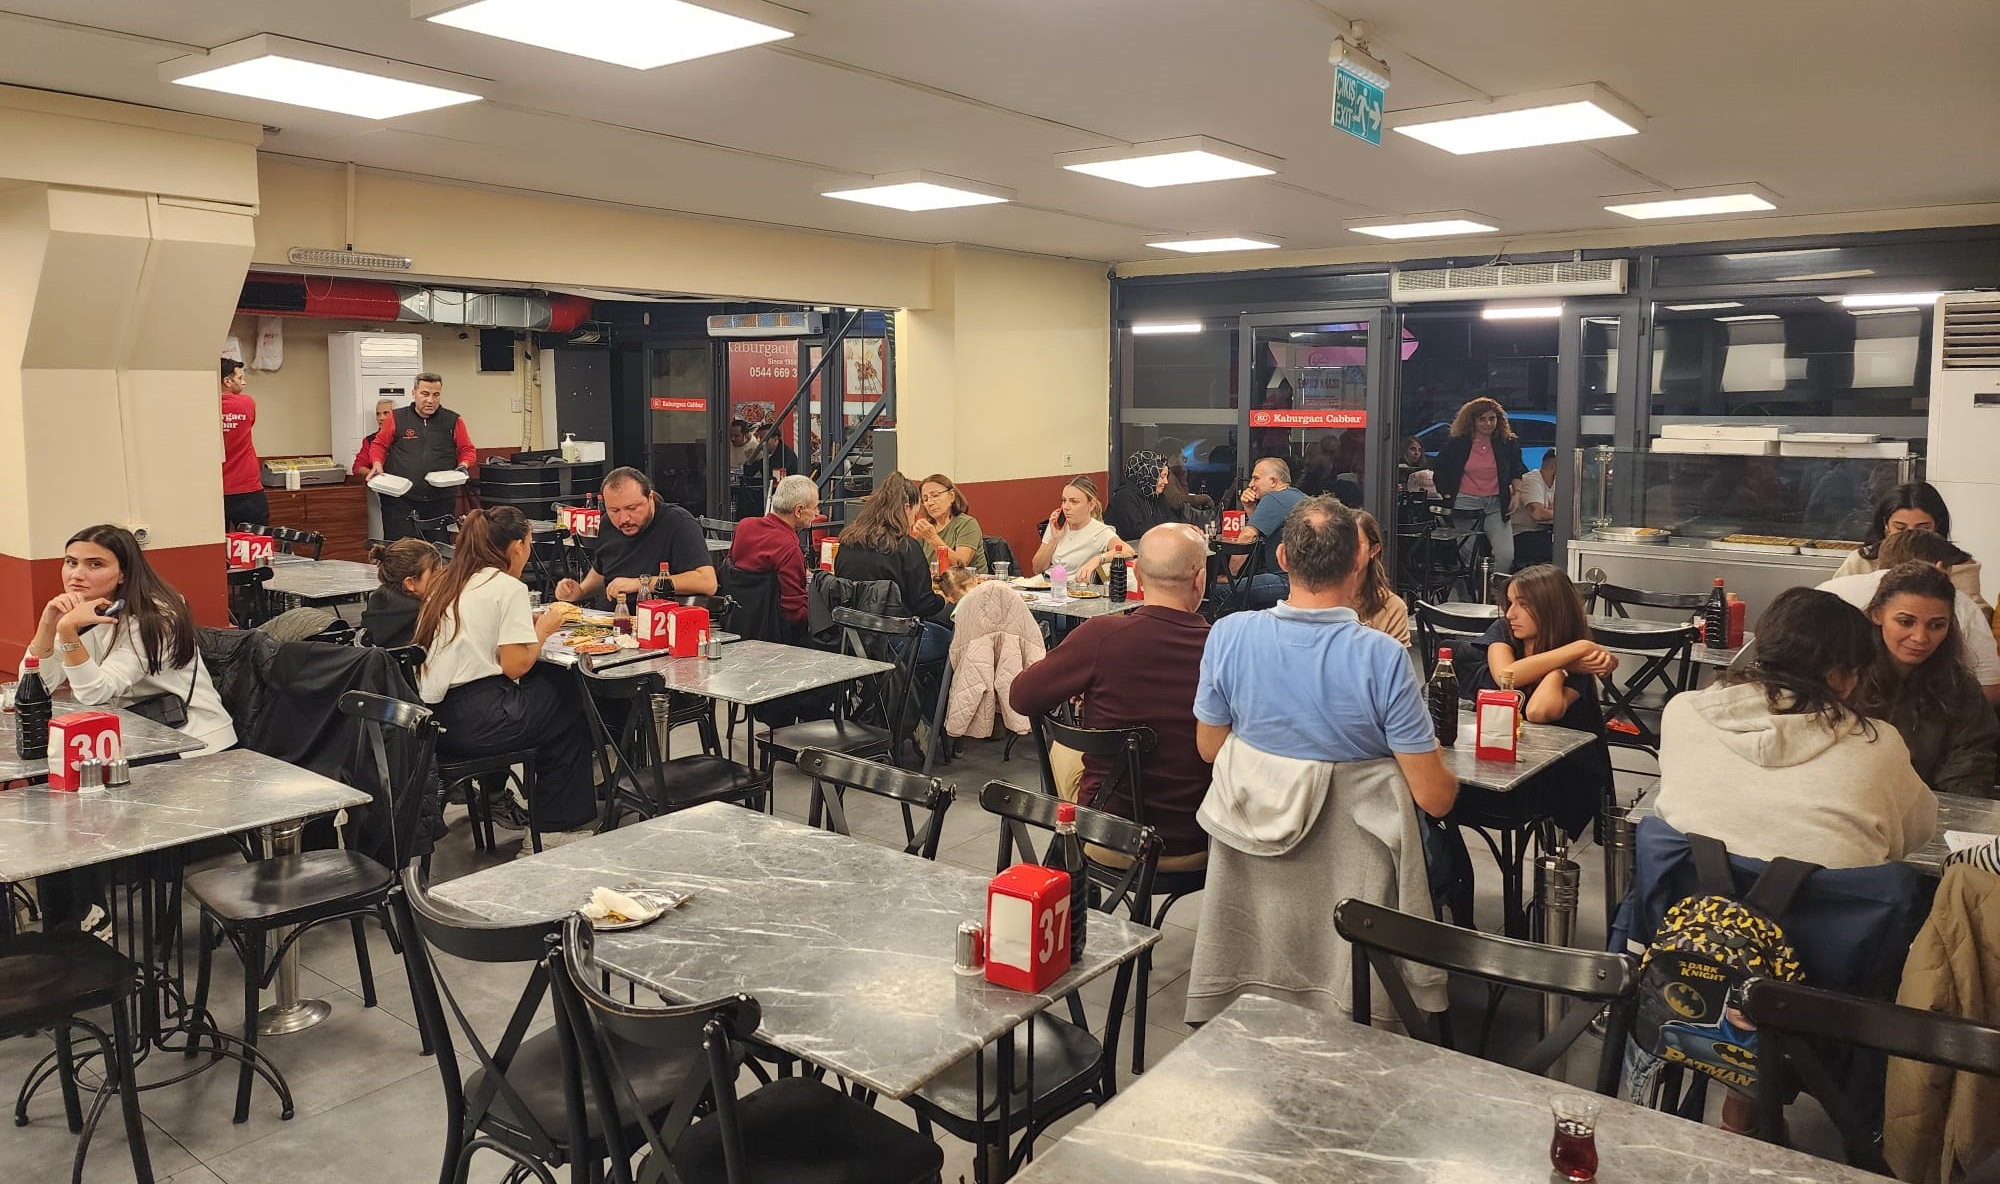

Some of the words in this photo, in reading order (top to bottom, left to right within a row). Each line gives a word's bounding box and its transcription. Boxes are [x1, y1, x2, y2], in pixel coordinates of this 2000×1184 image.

[1336, 73, 1356, 106] ÇIKIŞ
[1335, 104, 1354, 129] EXIT
[749, 367, 771, 378] 0544
[774, 367, 790, 378] 669
[1273, 414, 1323, 424] Kaburgacı
[1326, 414, 1361, 423] Cabbar
[587, 514, 600, 528] 25
[1224, 516, 1239, 531] 26
[251, 541, 273, 561] 24
[653, 611, 669, 637] 2
[69, 729, 120, 772] 30
[1039, 895, 1070, 963] 37
[1680, 967, 1727, 982] KNIGHT
[1688, 962, 1720, 973] DARK
[1663, 1045, 1757, 1087] BATMAN
